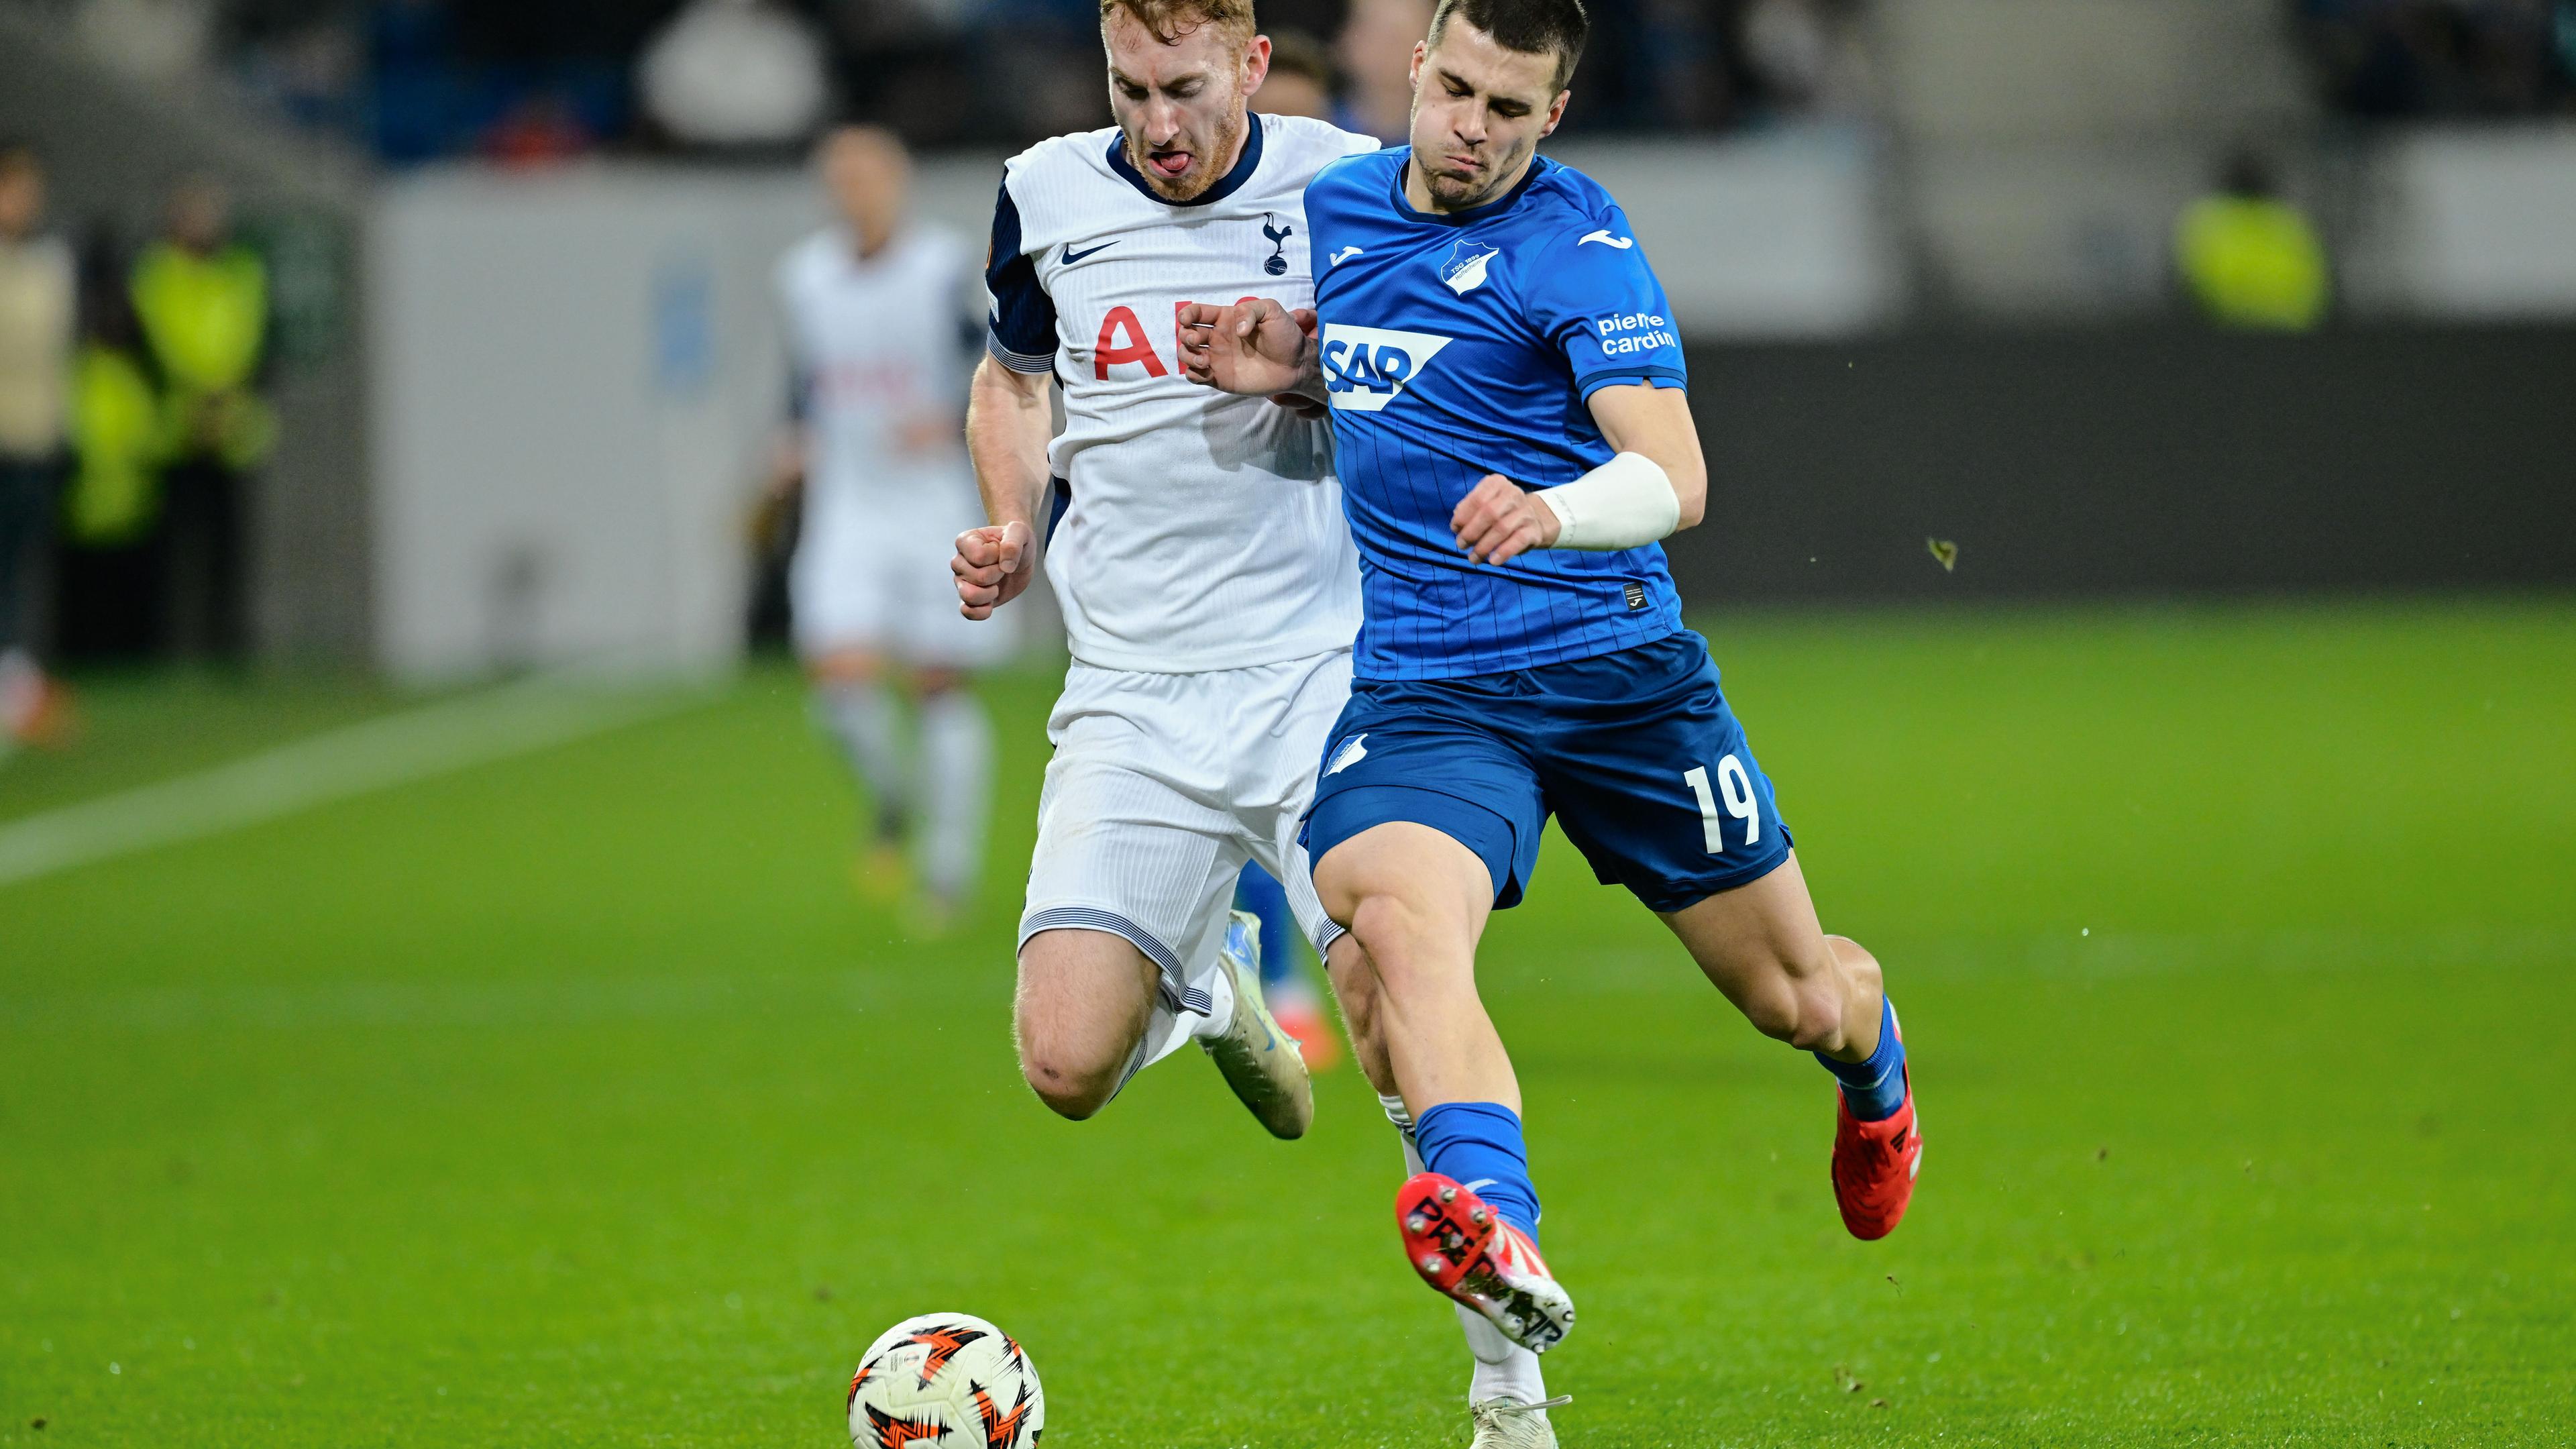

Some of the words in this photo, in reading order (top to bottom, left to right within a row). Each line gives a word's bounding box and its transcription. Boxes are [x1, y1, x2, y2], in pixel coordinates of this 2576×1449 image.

[1450, 262, 1464, 274] TSG
[1464, 254, 1480, 264] 1899
[1455, 260, 1482, 280] Hoffenheim
[1601, 329, 1676, 356] cardin
[1321, 339, 1411, 394] SAP
[1683, 753, 1760, 855] 19
